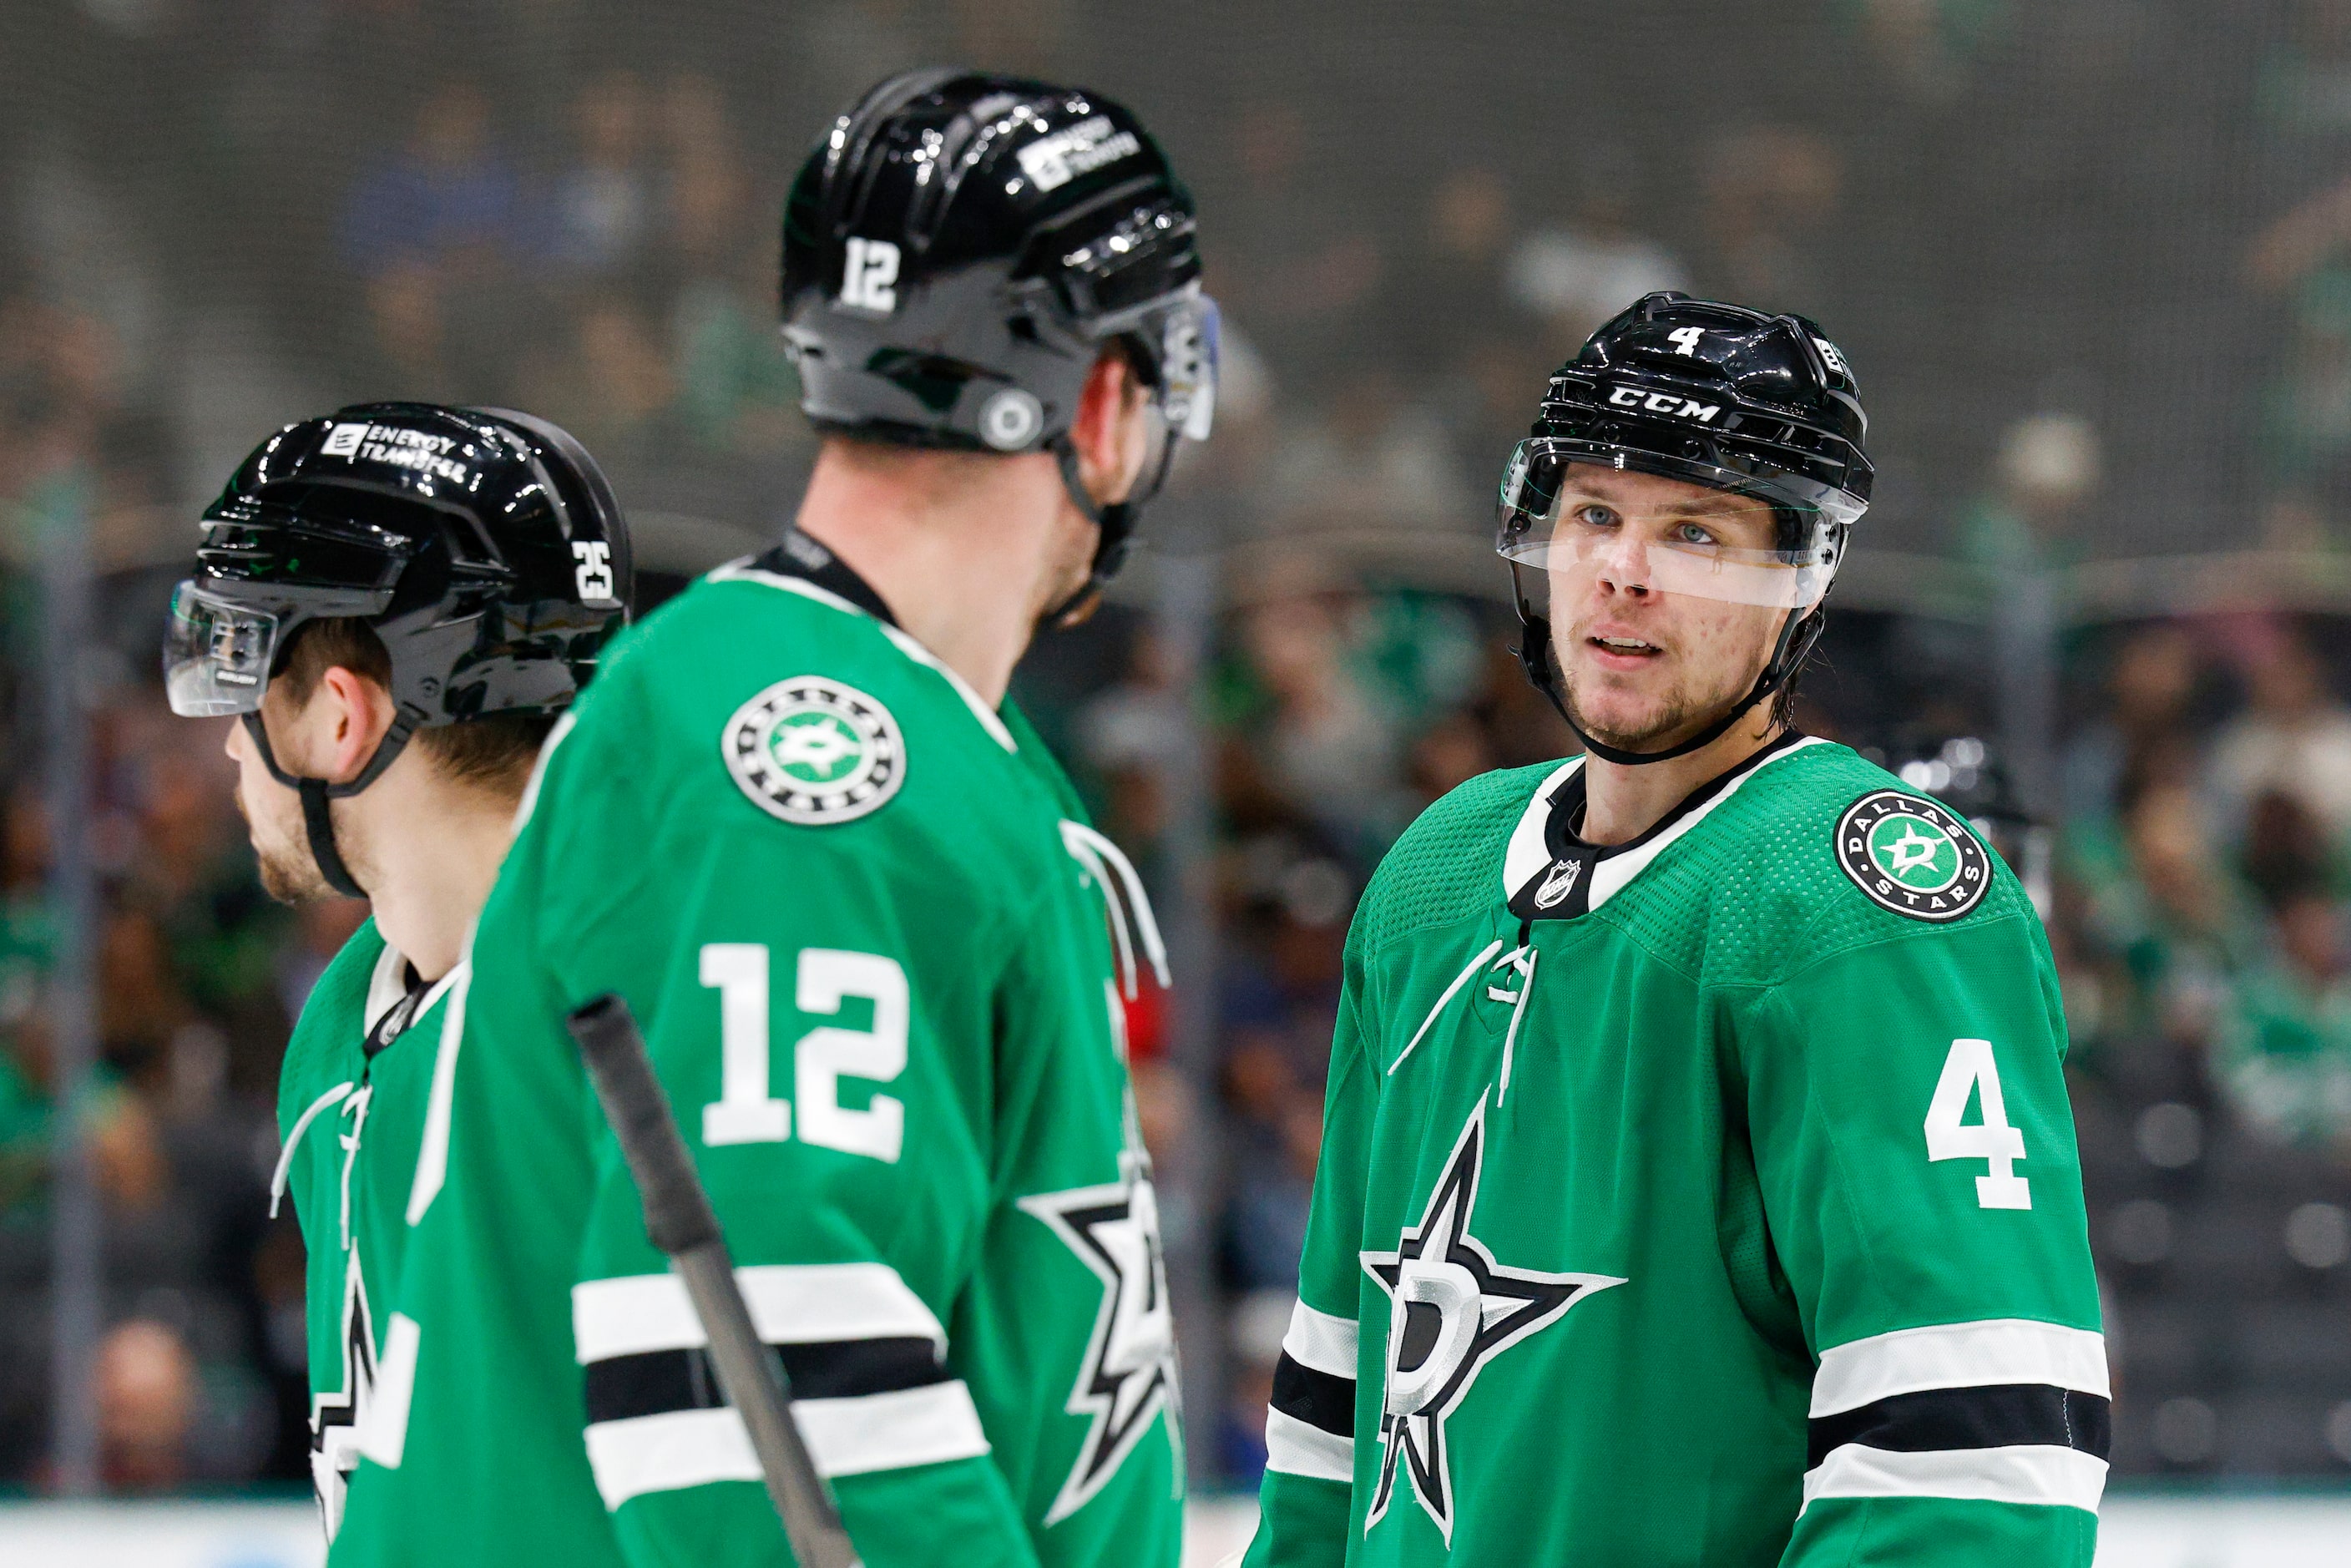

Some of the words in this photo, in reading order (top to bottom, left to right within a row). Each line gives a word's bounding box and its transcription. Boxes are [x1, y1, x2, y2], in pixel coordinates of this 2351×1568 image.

[840, 236, 902, 311] 12
[1667, 326, 1706, 357] 4
[1608, 386, 1722, 422] CCM
[367, 424, 457, 456] ENERGY
[571, 541, 614, 599] 25
[1848, 799, 1963, 854] DALLAS
[1875, 865, 1980, 909] STARS
[698, 943, 910, 1165] 12
[1924, 1038, 2032, 1210] 4
